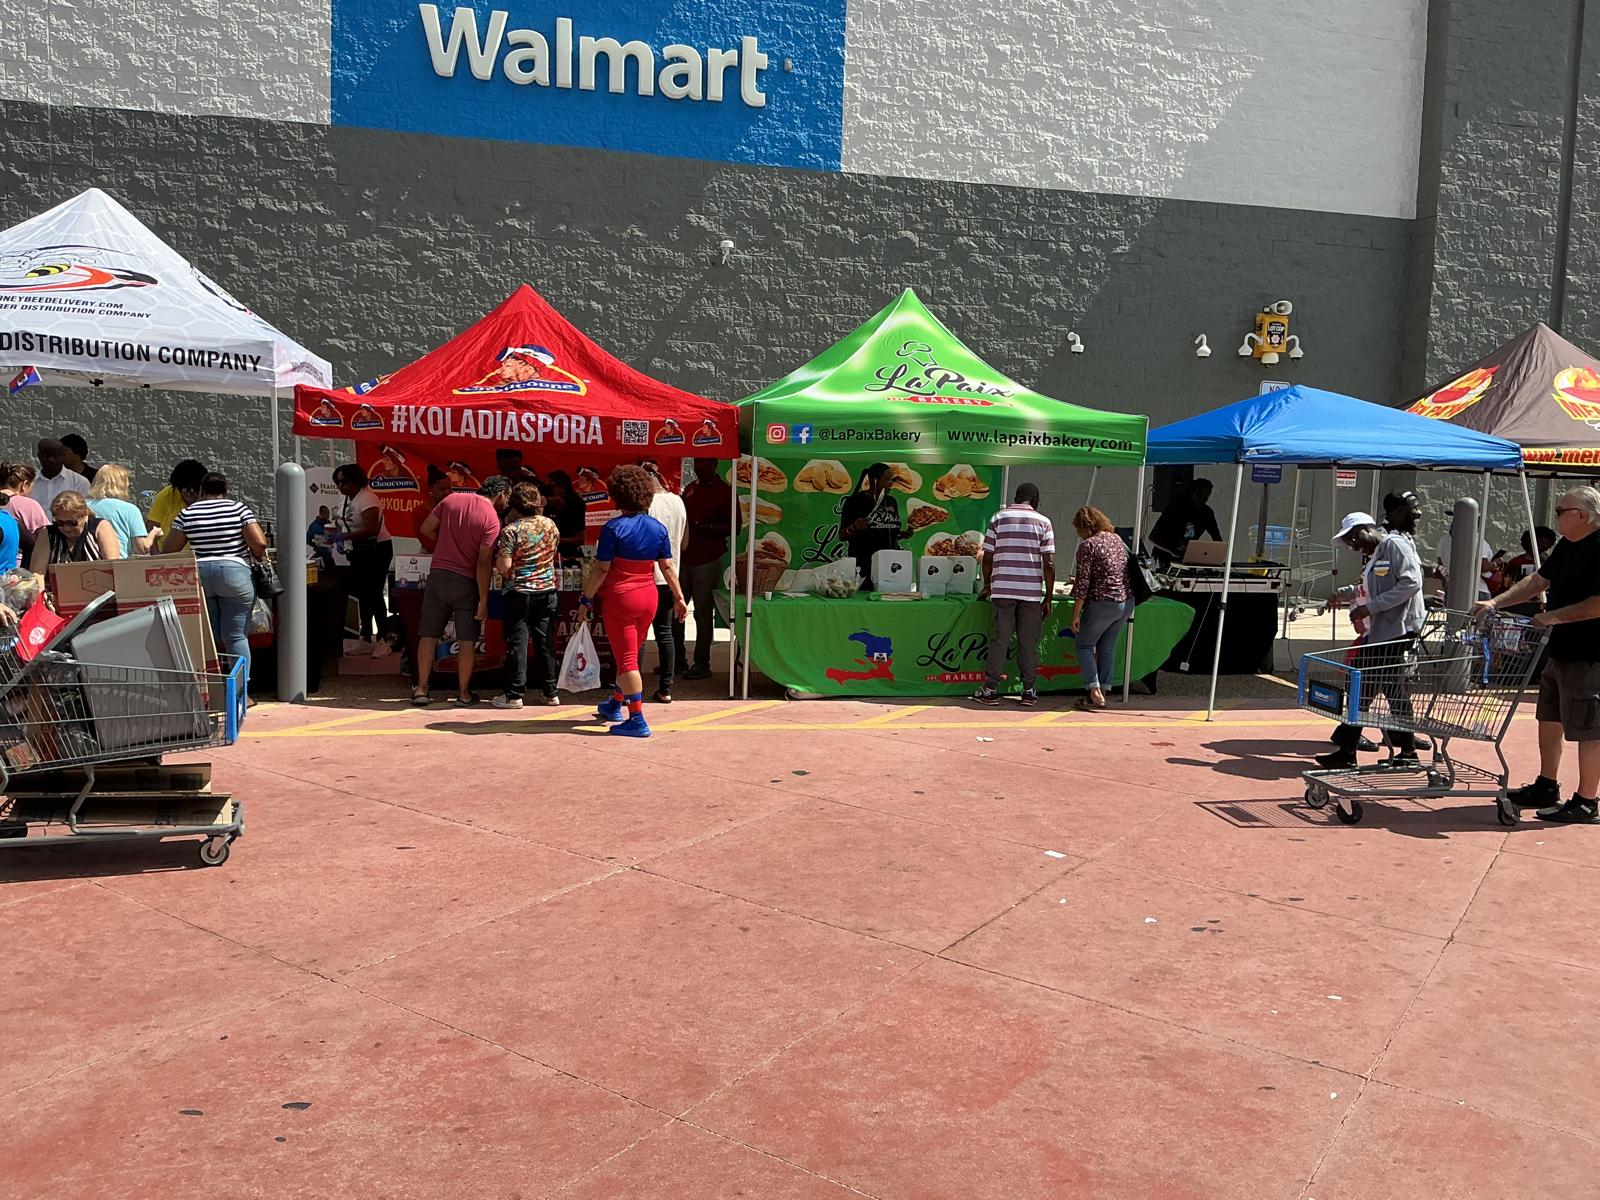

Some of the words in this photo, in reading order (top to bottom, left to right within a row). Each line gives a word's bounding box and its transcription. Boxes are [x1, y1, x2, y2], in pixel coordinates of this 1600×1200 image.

[419, 3, 768, 107] Walmart
[20, 304, 95, 314] DISTRIBUTION
[98, 309, 152, 319] COMPANY
[0, 331, 150, 362] DISTRIBUTION
[158, 346, 262, 373] COMPANY
[865, 363, 936, 396] La
[924, 367, 1016, 398] Paix
[918, 395, 982, 406] BAKERY
[391, 404, 604, 445] #KOLADIASPORA
[818, 428, 921, 443] @LaPaixBakery
[947, 430, 1133, 452] www.lapaixbakery.com
[380, 497, 424, 512] #KOLAD
[917, 631, 960, 672] La
[945, 672, 988, 682] BAKER
